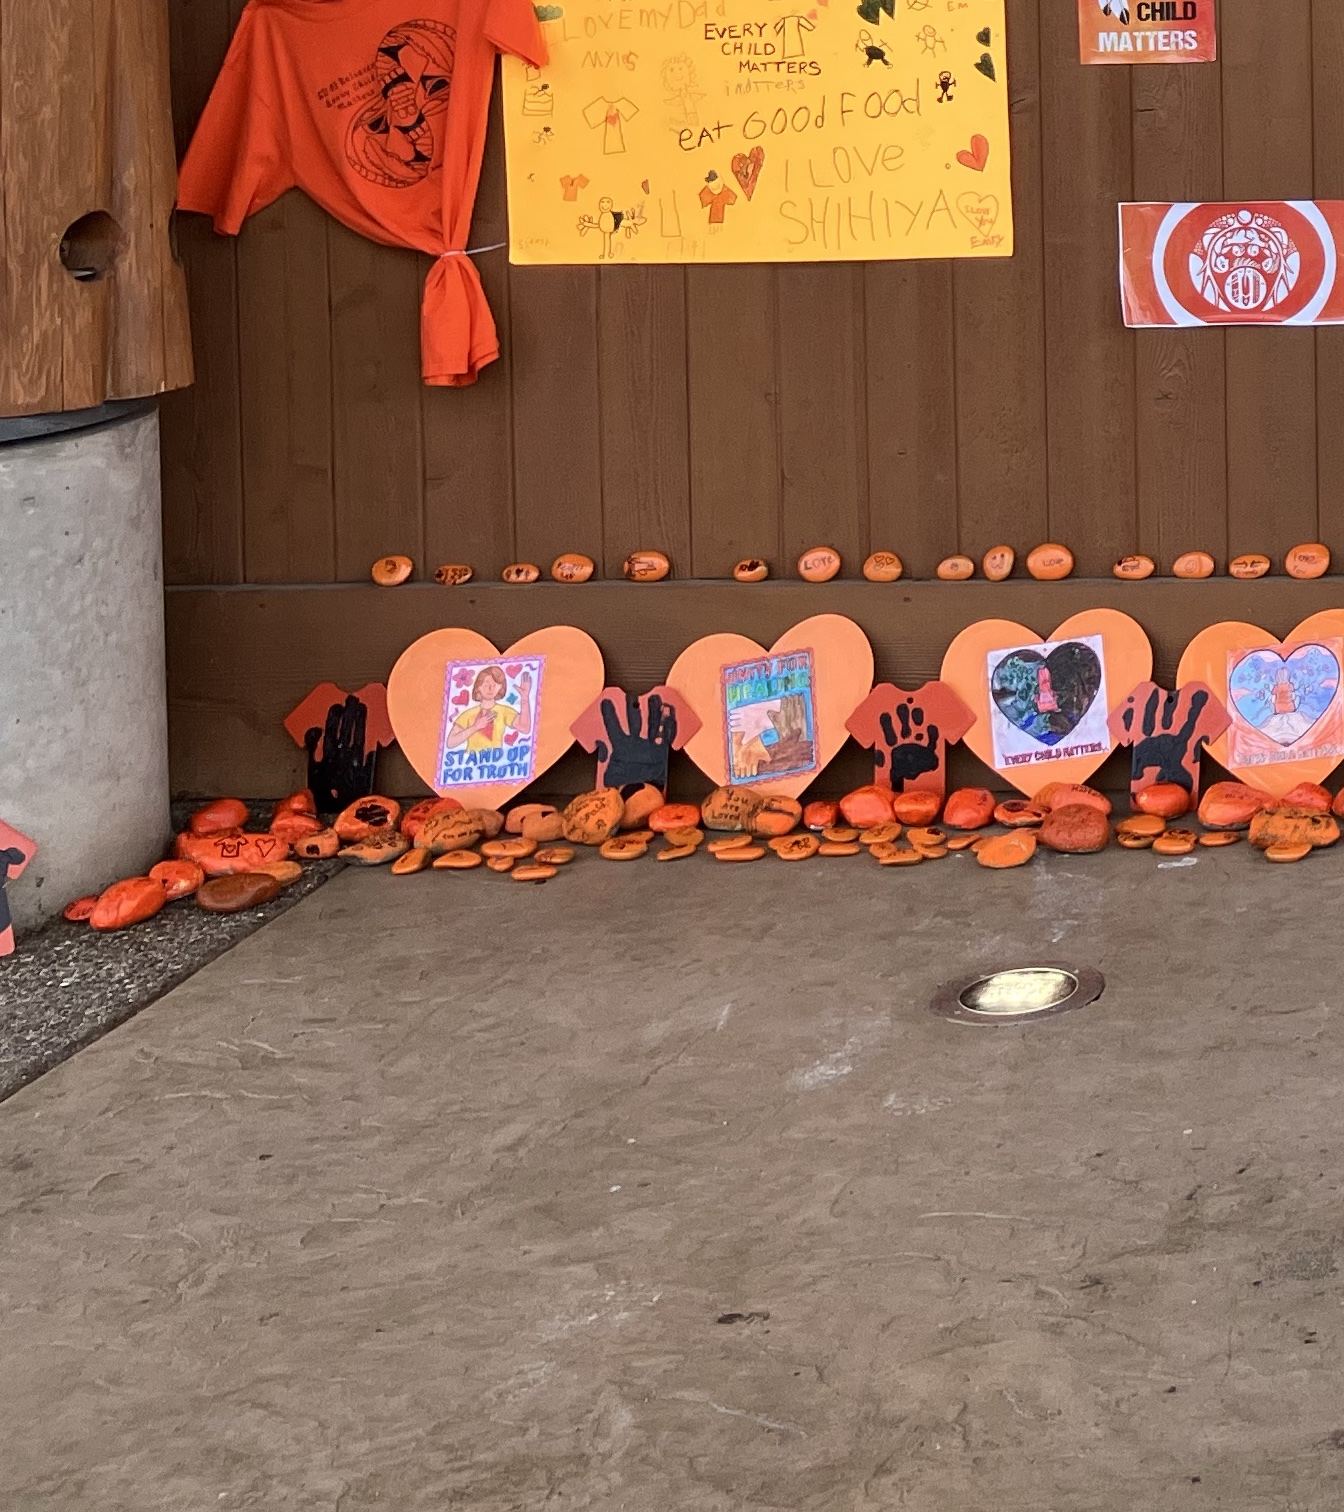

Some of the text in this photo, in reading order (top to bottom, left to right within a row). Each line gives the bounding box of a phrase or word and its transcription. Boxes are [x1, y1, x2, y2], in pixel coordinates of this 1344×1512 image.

[1136, 1, 1197, 22] CHILD
[703, 23, 768, 41] EVERY
[1098, 30, 1198, 53] MATTERS
[721, 43, 776, 56] CHILD
[738, 60, 823, 77] MATTERS
[779, 190, 958, 250] SHIHIYA
[727, 671, 810, 703] HEALING
[444, 747, 504, 767] STAND
[443, 766, 473, 784] FOR
